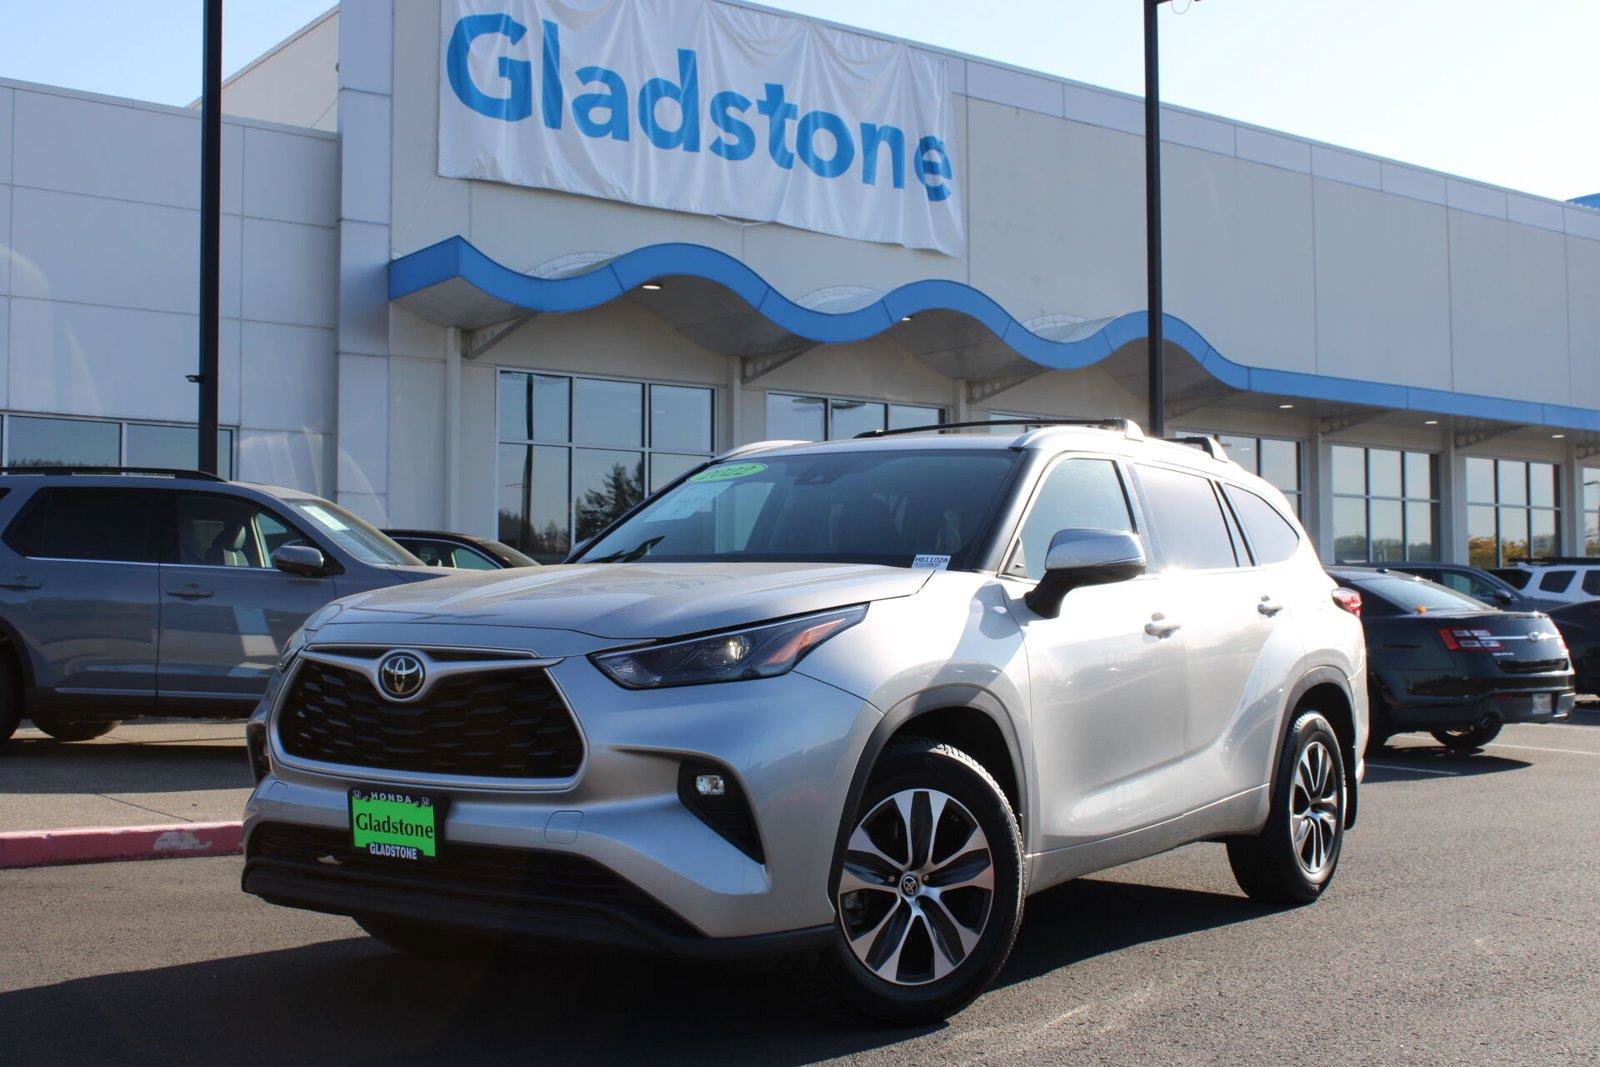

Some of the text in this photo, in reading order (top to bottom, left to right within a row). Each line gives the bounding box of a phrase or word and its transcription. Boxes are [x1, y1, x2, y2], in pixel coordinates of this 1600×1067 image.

[447, 13, 952, 201] Gladstone
[370, 791, 412, 804] HONDA
[355, 812, 434, 839] Gladstone
[369, 842, 418, 860] GLADSTONE
